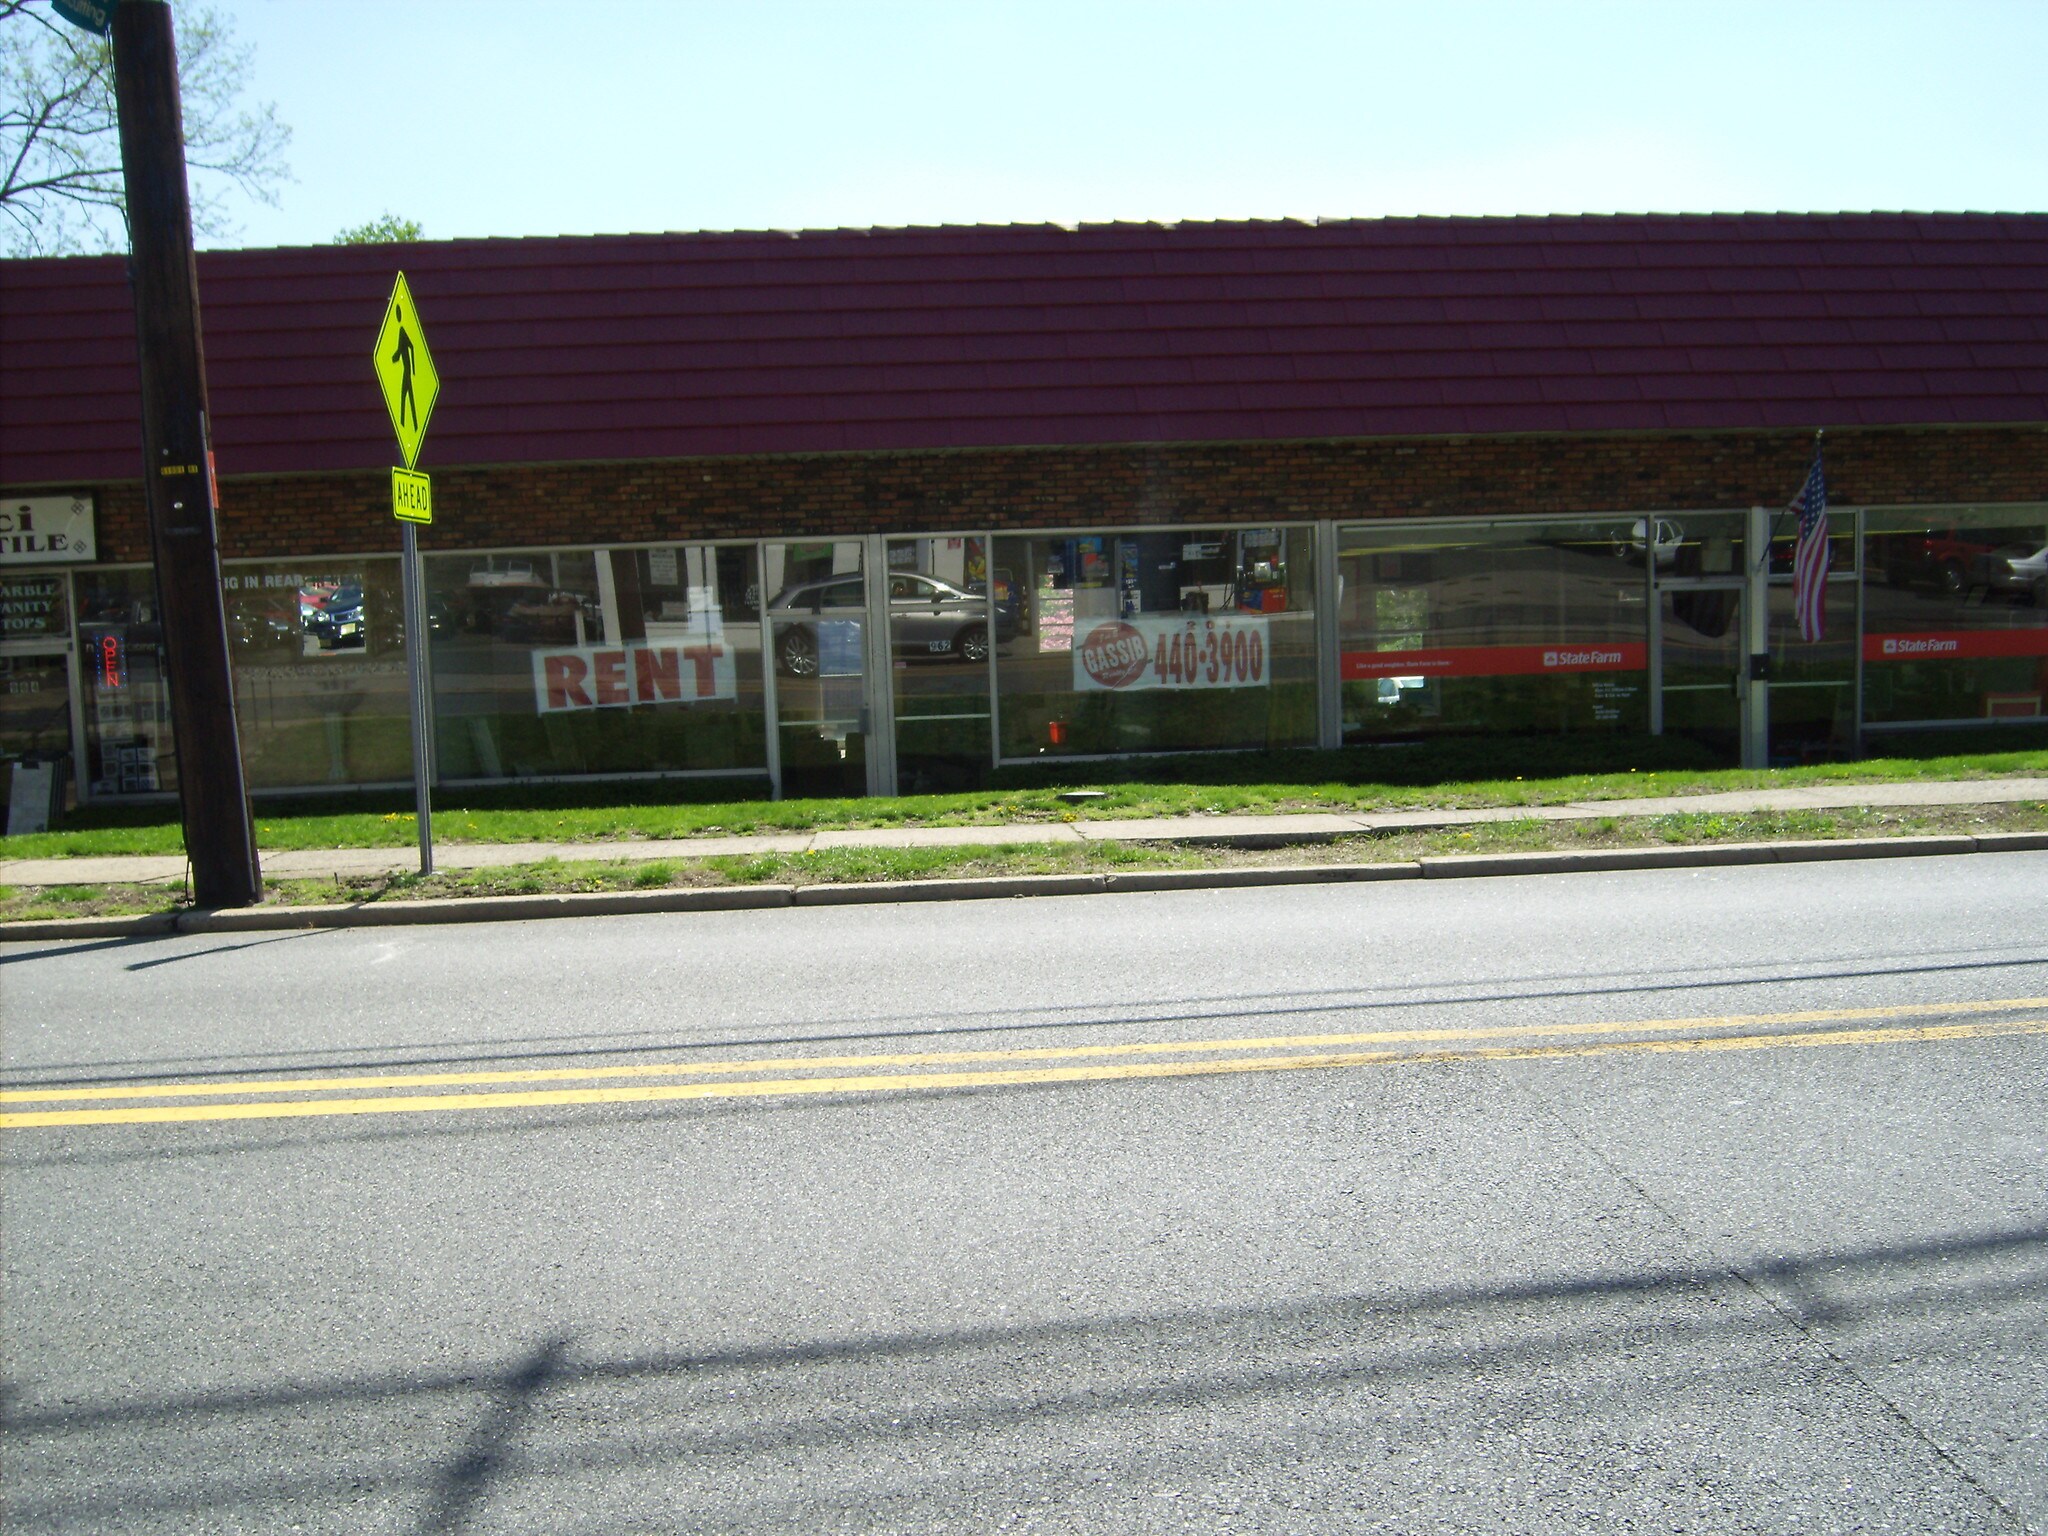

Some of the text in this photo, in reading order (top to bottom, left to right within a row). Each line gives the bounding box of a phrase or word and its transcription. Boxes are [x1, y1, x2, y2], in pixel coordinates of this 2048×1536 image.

[397, 481, 428, 511] AHEAD
[244, 575, 259, 588] IN
[265, 574, 304, 588] REAR
[2, 617, 46, 630] TOPS
[930, 640, 951, 651] 962
[1084, 635, 1146, 673] GASSIB
[102, 636, 120, 688] OPEN
[543, 644, 724, 709] RENT
